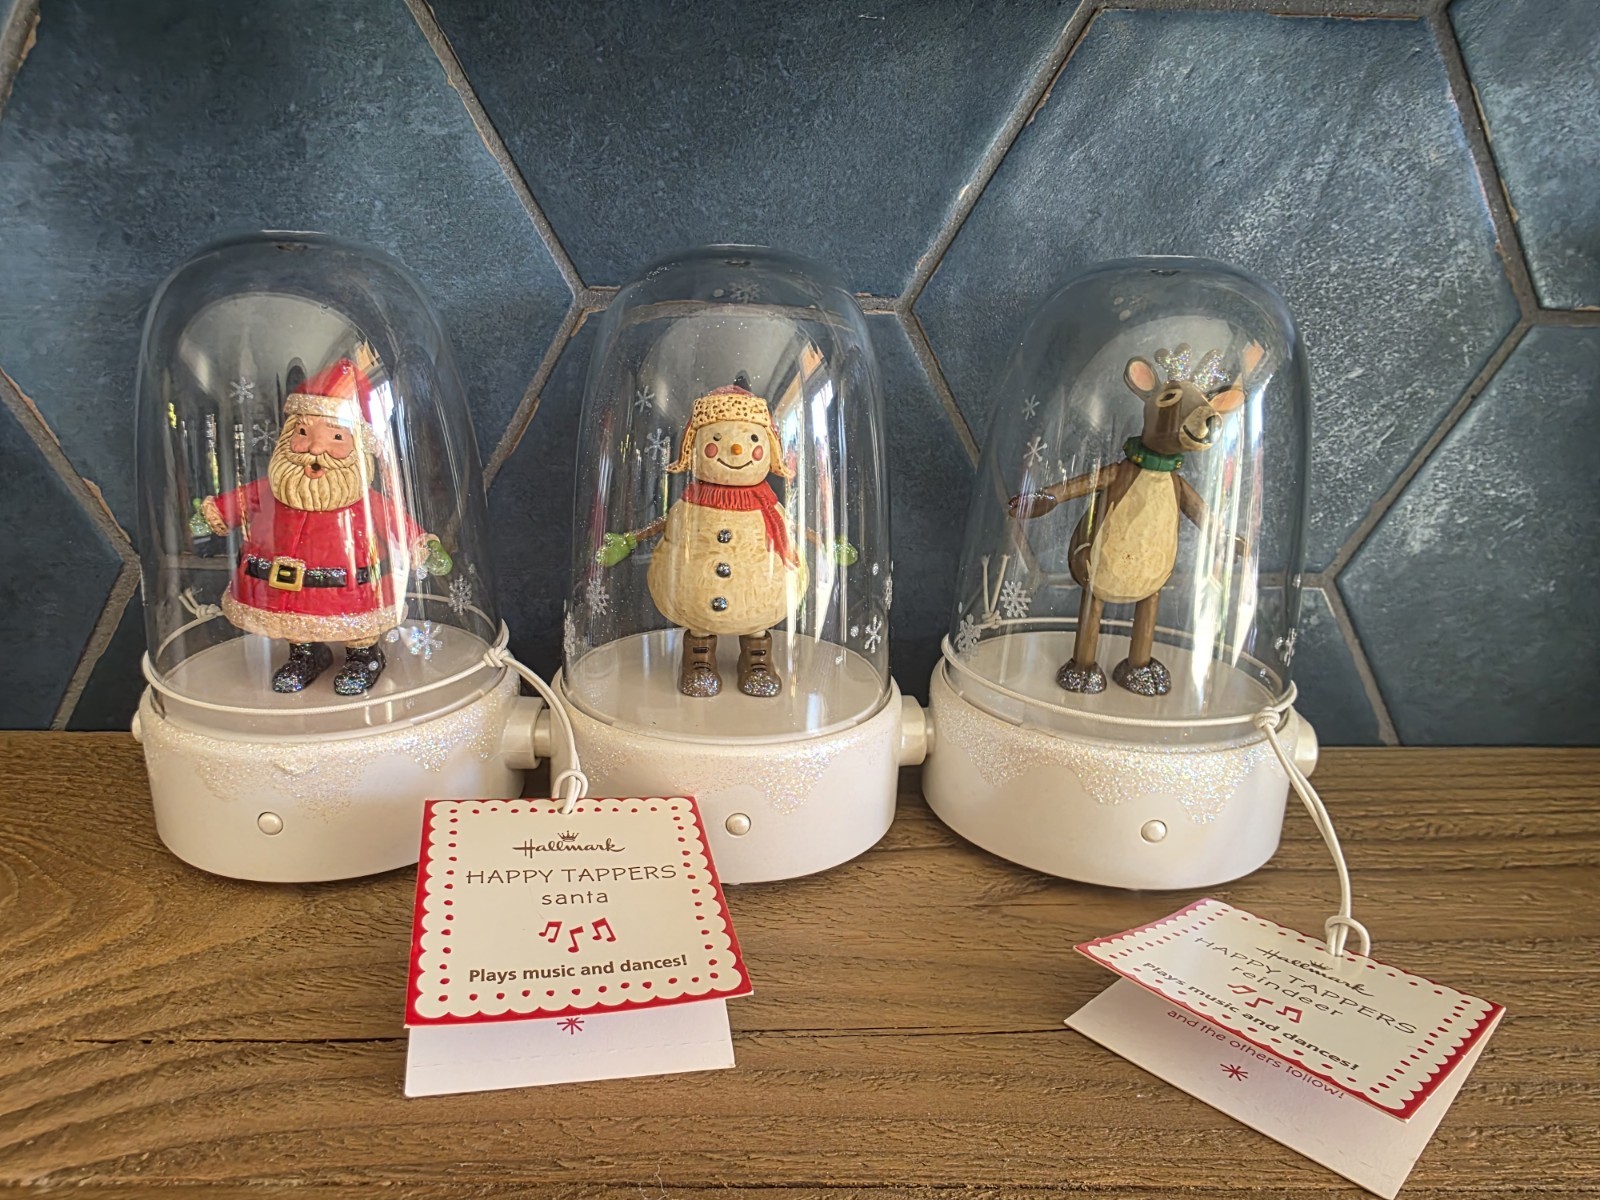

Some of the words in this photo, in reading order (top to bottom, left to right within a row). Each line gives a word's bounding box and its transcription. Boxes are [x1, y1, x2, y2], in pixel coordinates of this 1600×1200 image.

[512, 838, 625, 858] Hallmark
[466, 869, 554, 884] HAPPY
[561, 864, 677, 883] TAPPERS
[541, 891, 608, 905] santa
[469, 967, 517, 983] Plays
[523, 964, 575, 980] music
[580, 961, 614, 977] and
[620, 954, 687, 972] dances!
[1194, 937, 1281, 974] HAPPY
[1289, 974, 1417, 1034] TAPPERS
[1231, 966, 1343, 1016] reindeer
[1256, 947, 1375, 997] Hallmark
[1143, 962, 1186, 986] Plays
[1188, 986, 1240, 1013] music
[1242, 1013, 1280, 1032] and
[1282, 1030, 1360, 1071] dances!
[1167, 1010, 1199, 1028] and
[1200, 1025, 1226, 1041] the
[1229, 1040, 1282, 1068] others
[1285, 1065, 1346, 1099] follow!
